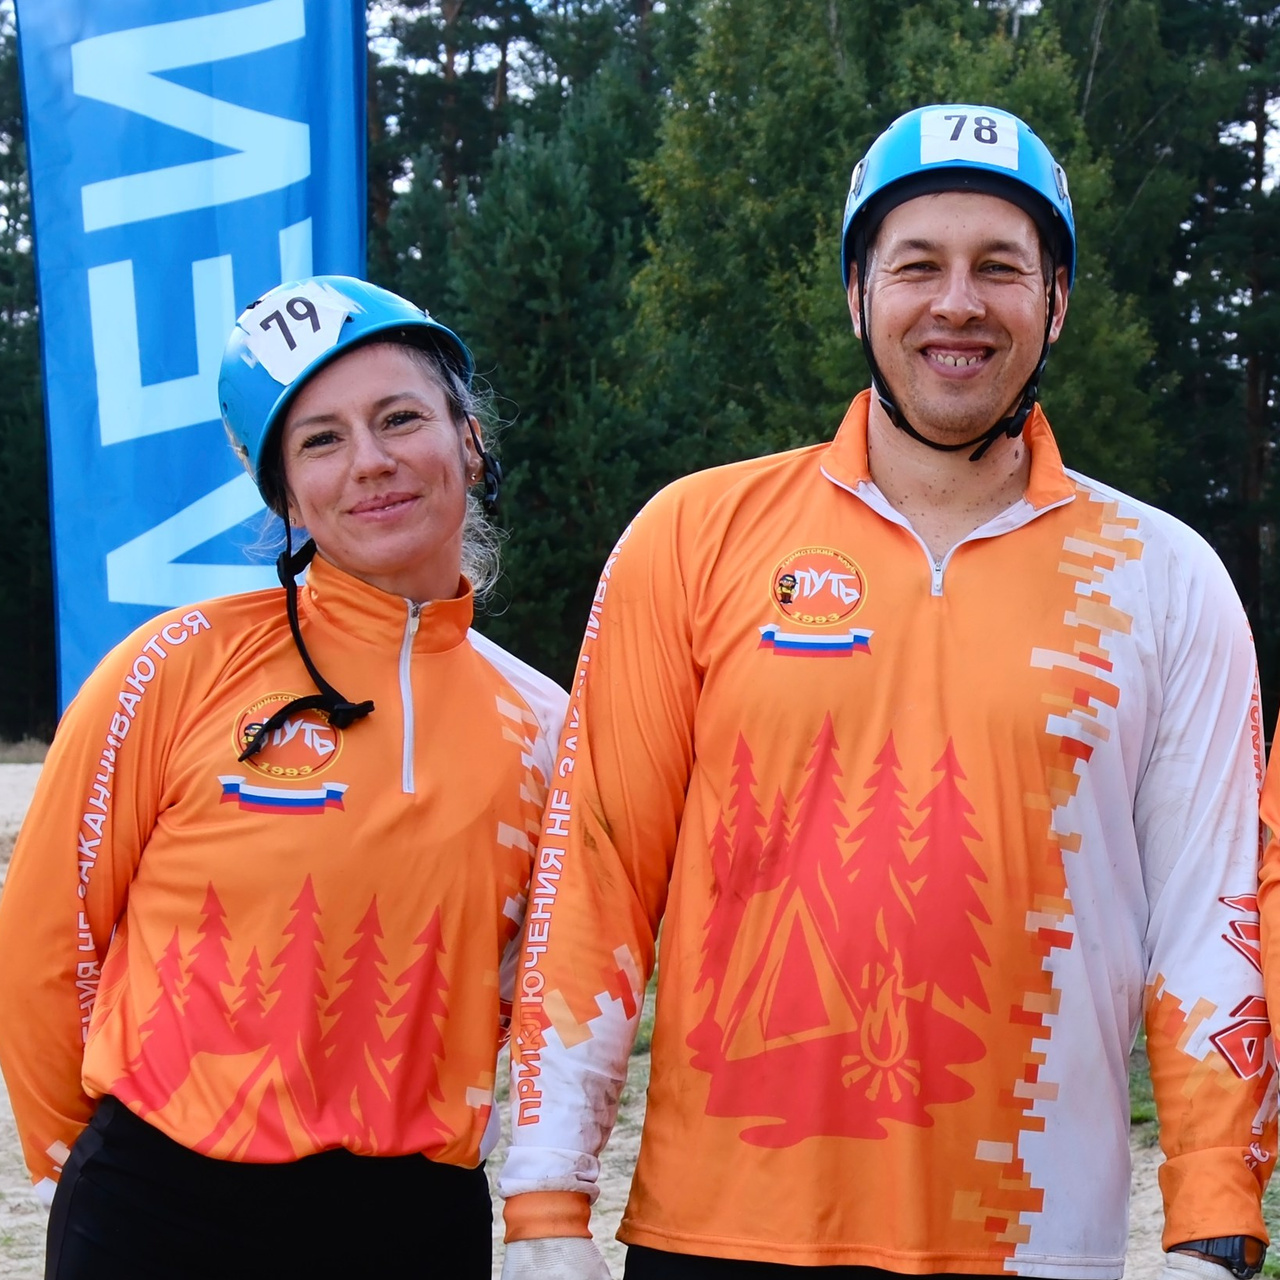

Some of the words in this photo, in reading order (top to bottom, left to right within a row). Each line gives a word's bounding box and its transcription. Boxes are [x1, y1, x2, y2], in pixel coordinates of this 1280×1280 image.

[944, 114, 998, 145] 78
[259, 296, 321, 351] 79
[793, 567, 860, 605] ПУТЬ
[791, 611, 840, 623] 1993
[76, 609, 212, 899] АКАНЧИВАЮТСЯ
[258, 761, 313, 777] 1993
[517, 846, 567, 1127] ПРИКЛЮЧЕНИЯ
[545, 788, 573, 837] НЕ
